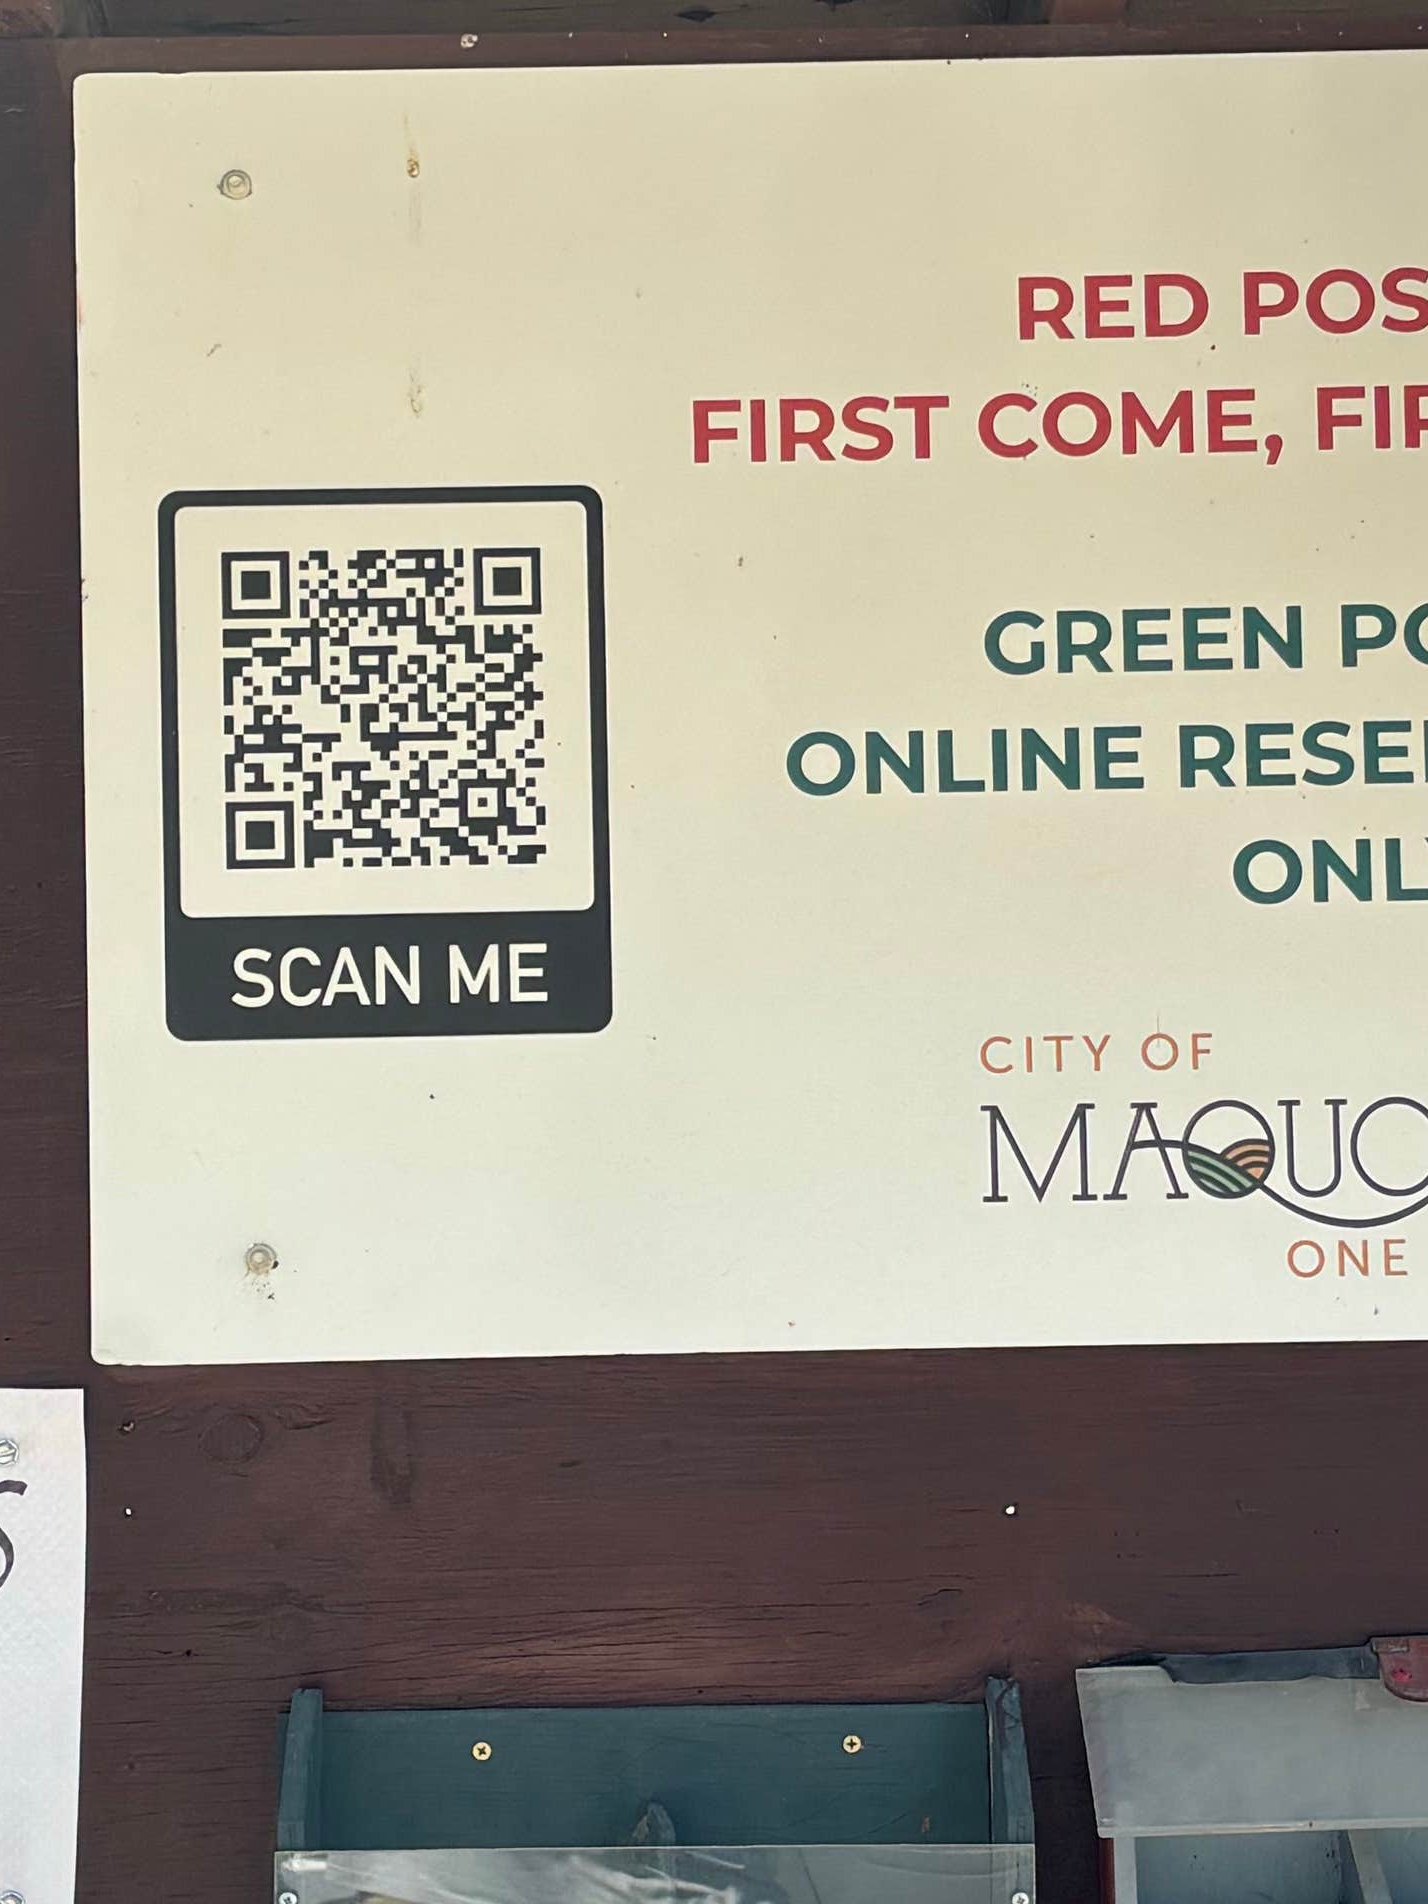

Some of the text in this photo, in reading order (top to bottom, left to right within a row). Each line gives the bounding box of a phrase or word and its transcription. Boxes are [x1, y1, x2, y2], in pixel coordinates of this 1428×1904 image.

[1018, 274, 1209, 340] RED
[693, 396, 949, 463] FIRST
[978, 389, 1283, 465] COME,
[984, 605, 1303, 675] GREEN
[787, 726, 1144, 796] ONLINE
[232, 944, 547, 1007] SCAN ME
[979, 1031, 1214, 1073] CITY OF
[1286, 1237, 1409, 1278] ONE
